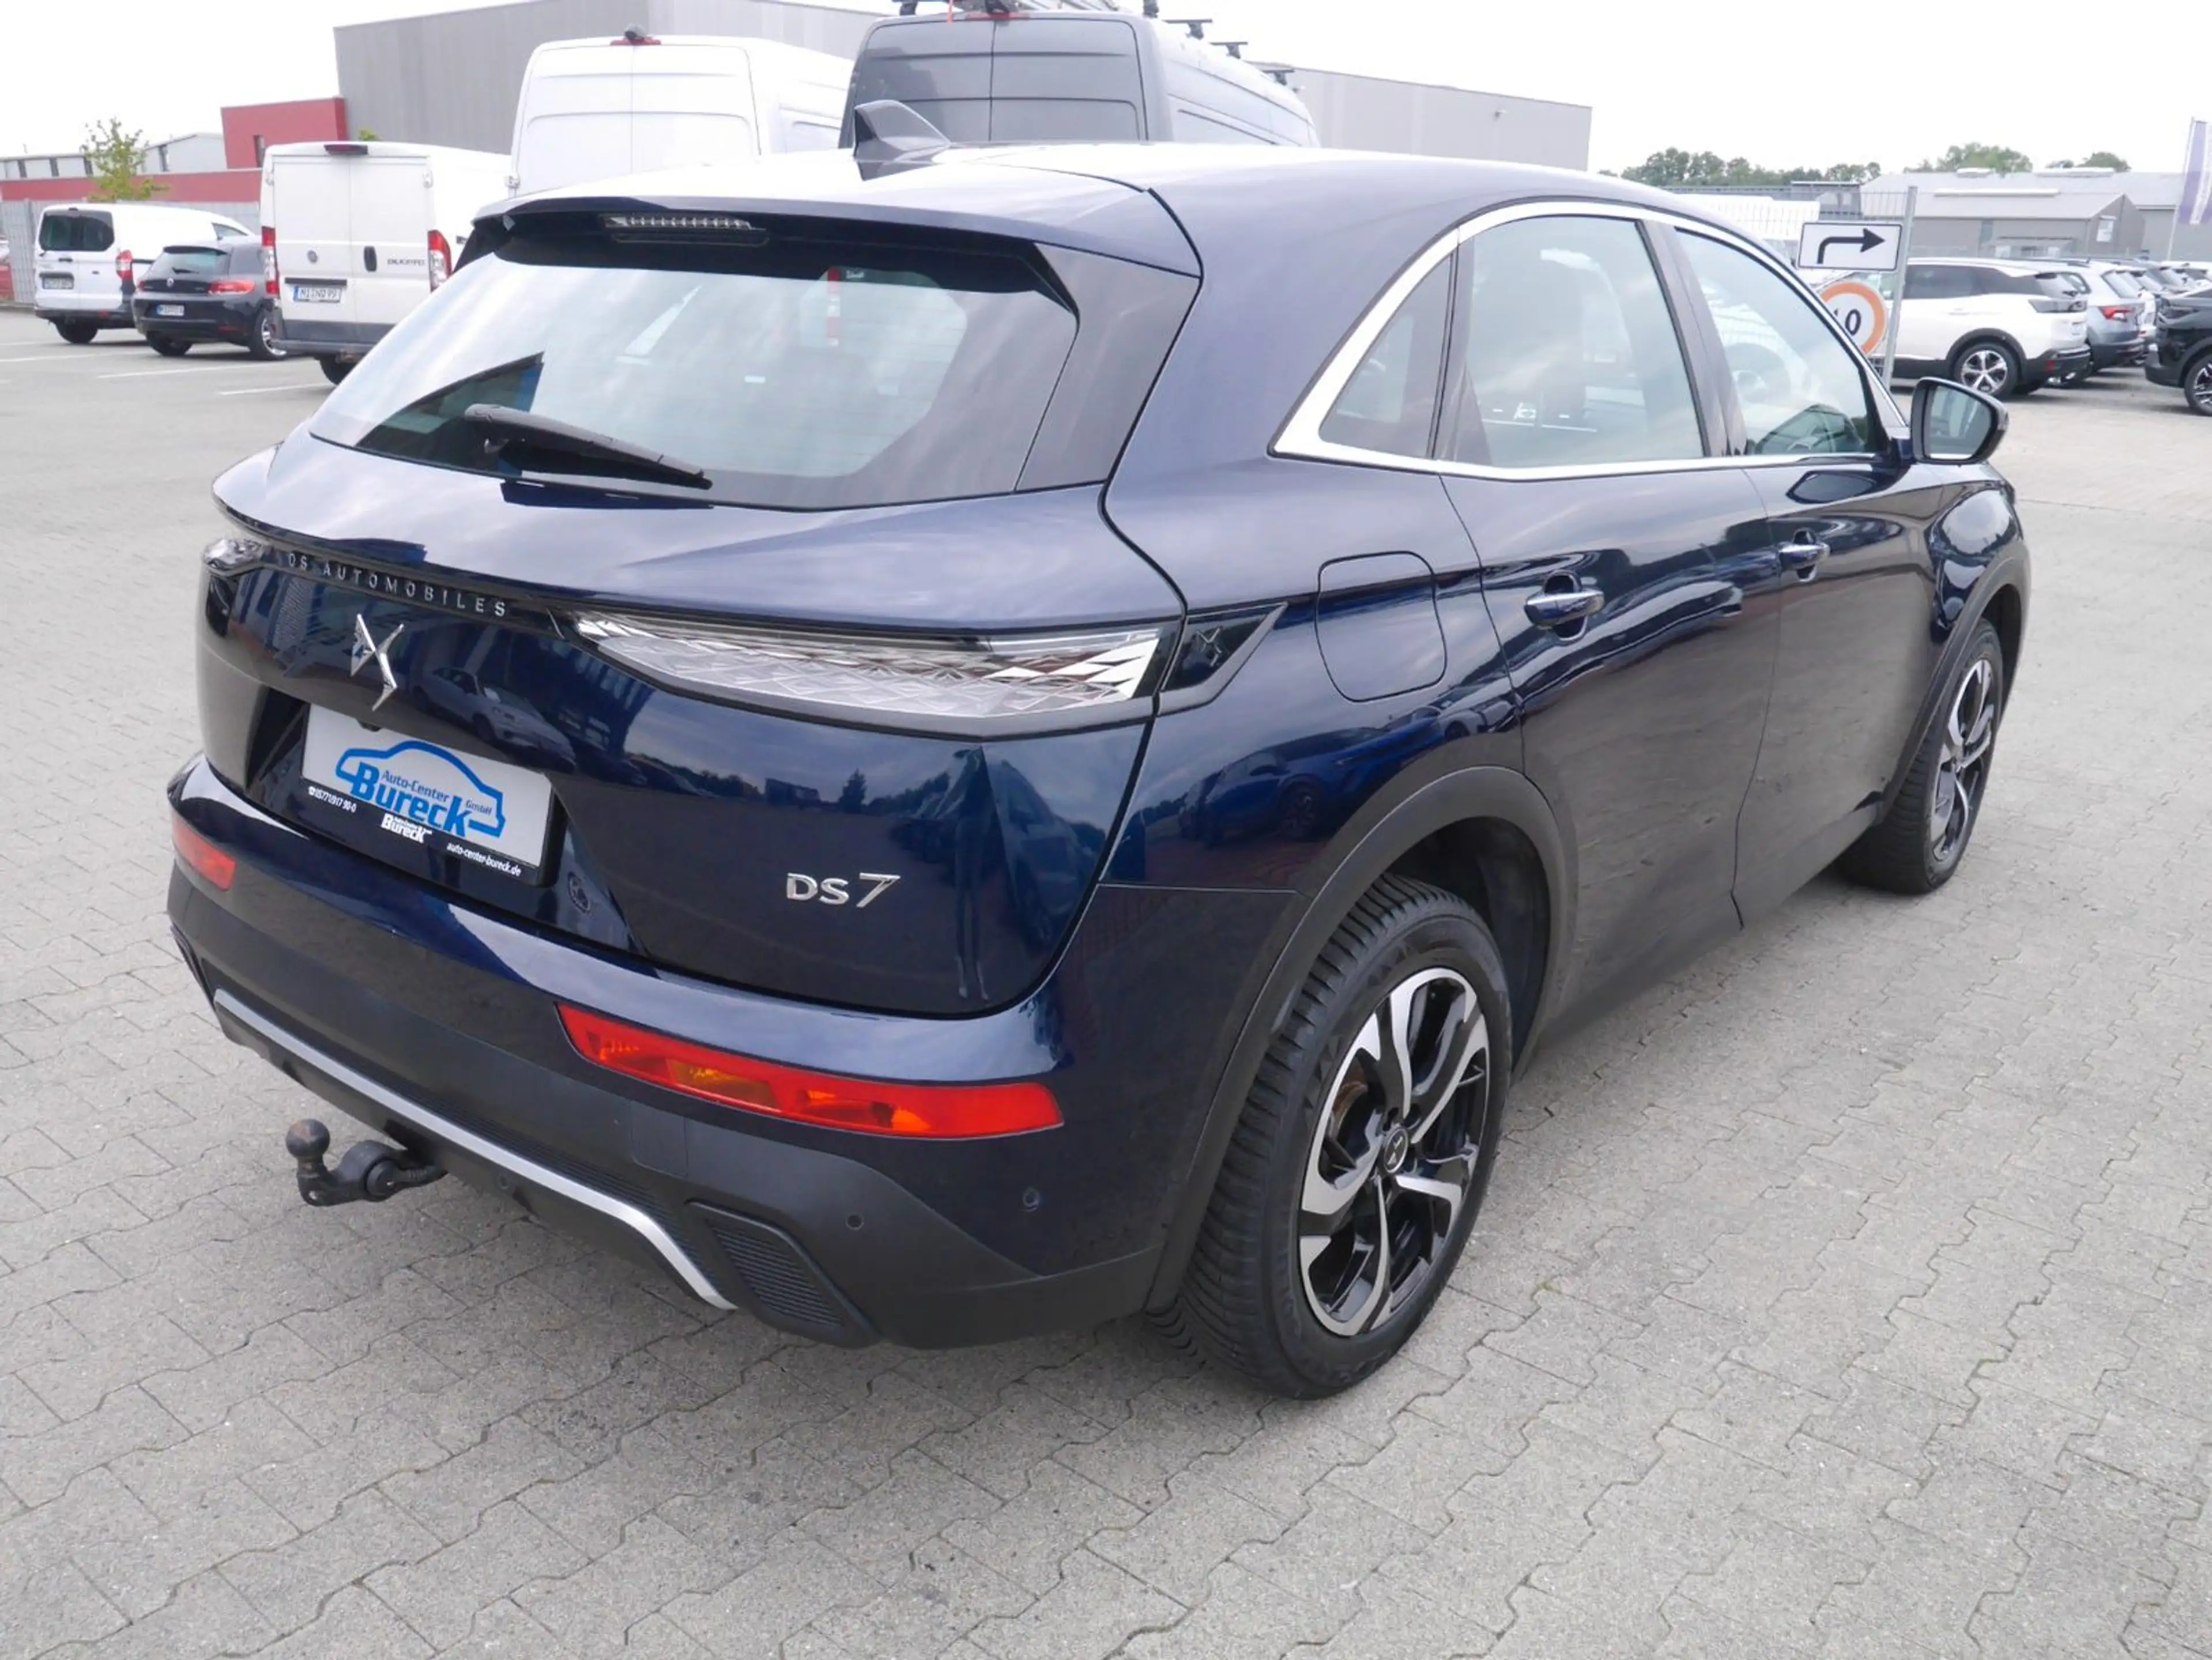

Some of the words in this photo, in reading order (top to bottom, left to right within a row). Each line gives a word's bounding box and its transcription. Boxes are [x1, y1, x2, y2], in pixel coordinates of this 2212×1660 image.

[288, 553, 308, 571] DS
[323, 561, 507, 618] AUTOMOBILES
[351, 761, 471, 837] Bureck
[382, 770, 451, 803] Auto-Center
[465, 799, 493, 815] GmbH
[380, 813, 425, 844] Bureck
